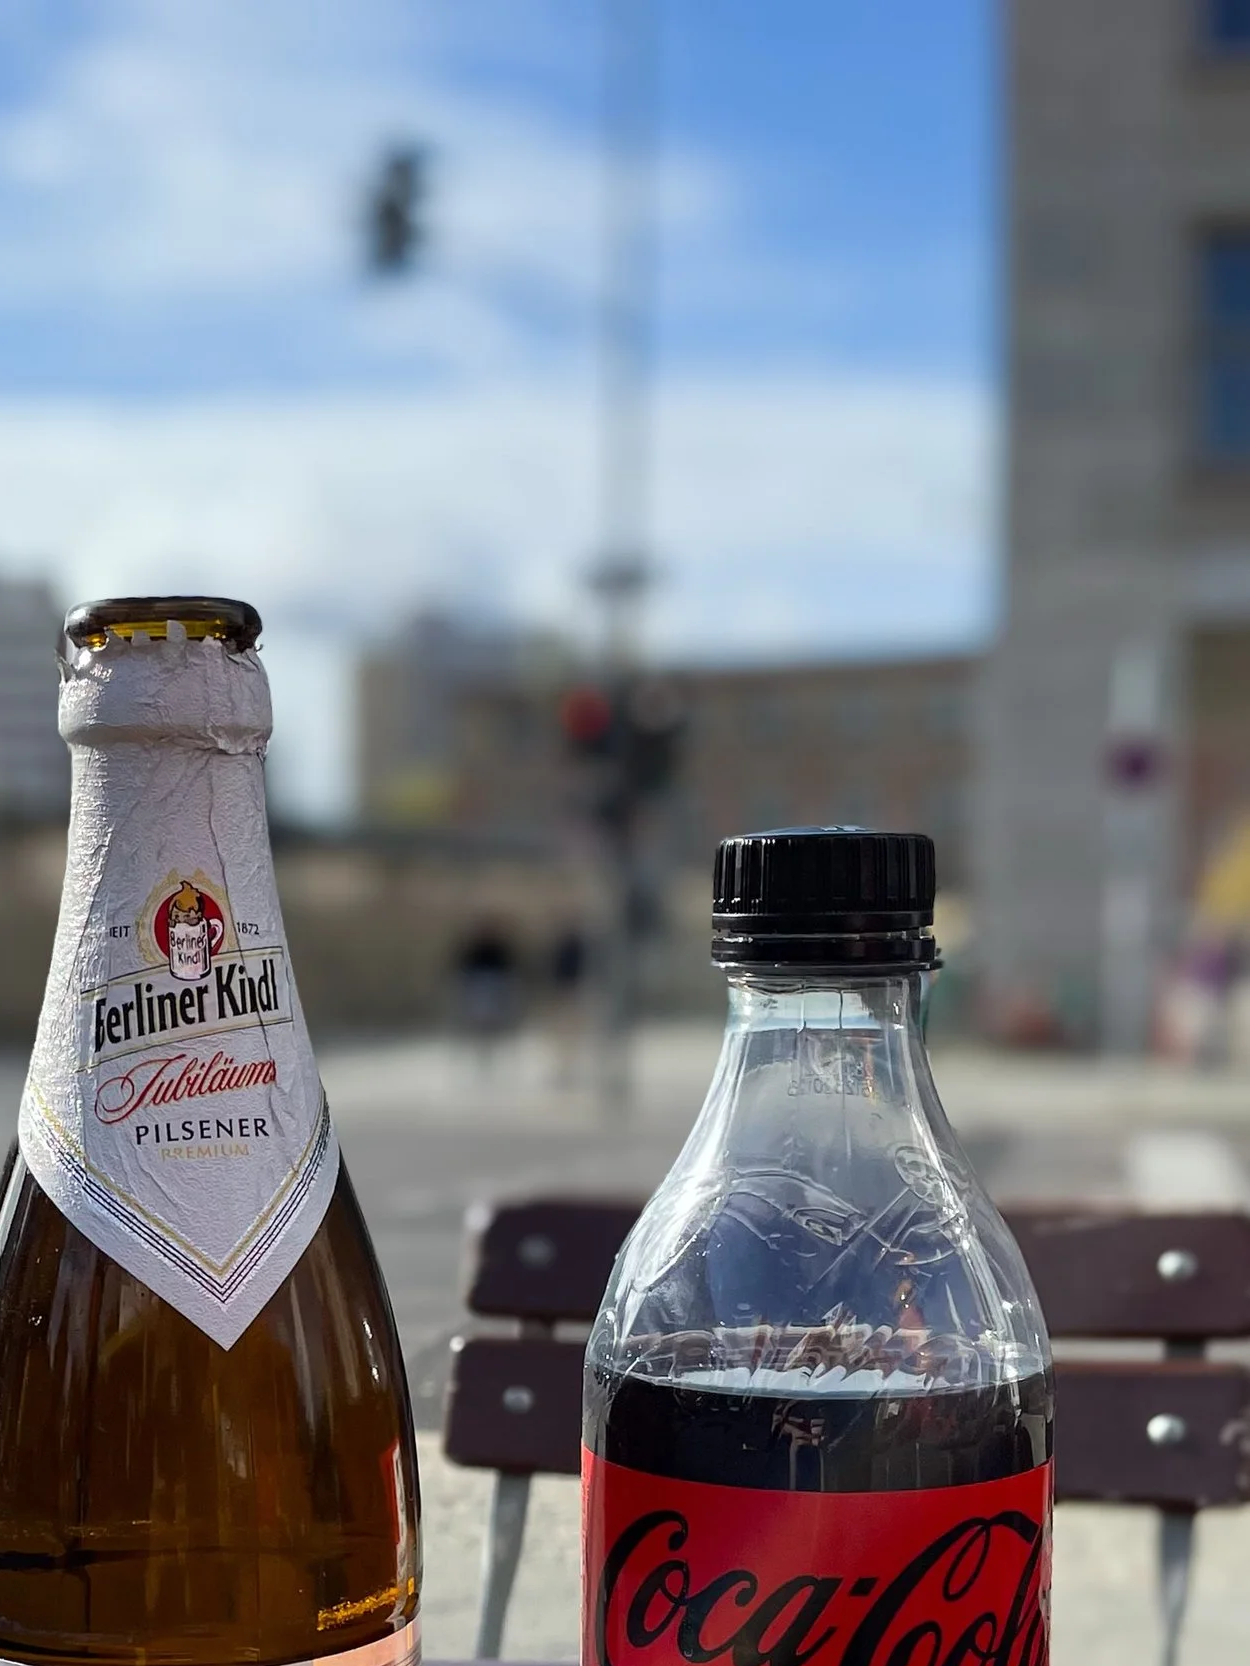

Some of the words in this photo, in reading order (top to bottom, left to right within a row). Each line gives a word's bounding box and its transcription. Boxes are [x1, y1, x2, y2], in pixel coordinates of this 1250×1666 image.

[236, 922, 260, 935] 1872
[170, 931, 207, 949] Berliner
[178, 951, 201, 965] Kindl
[215, 959, 279, 1021] Kindl
[136, 1118, 270, 1146] PILSENER
[161, 1143, 249, 1163] PREMIUM
